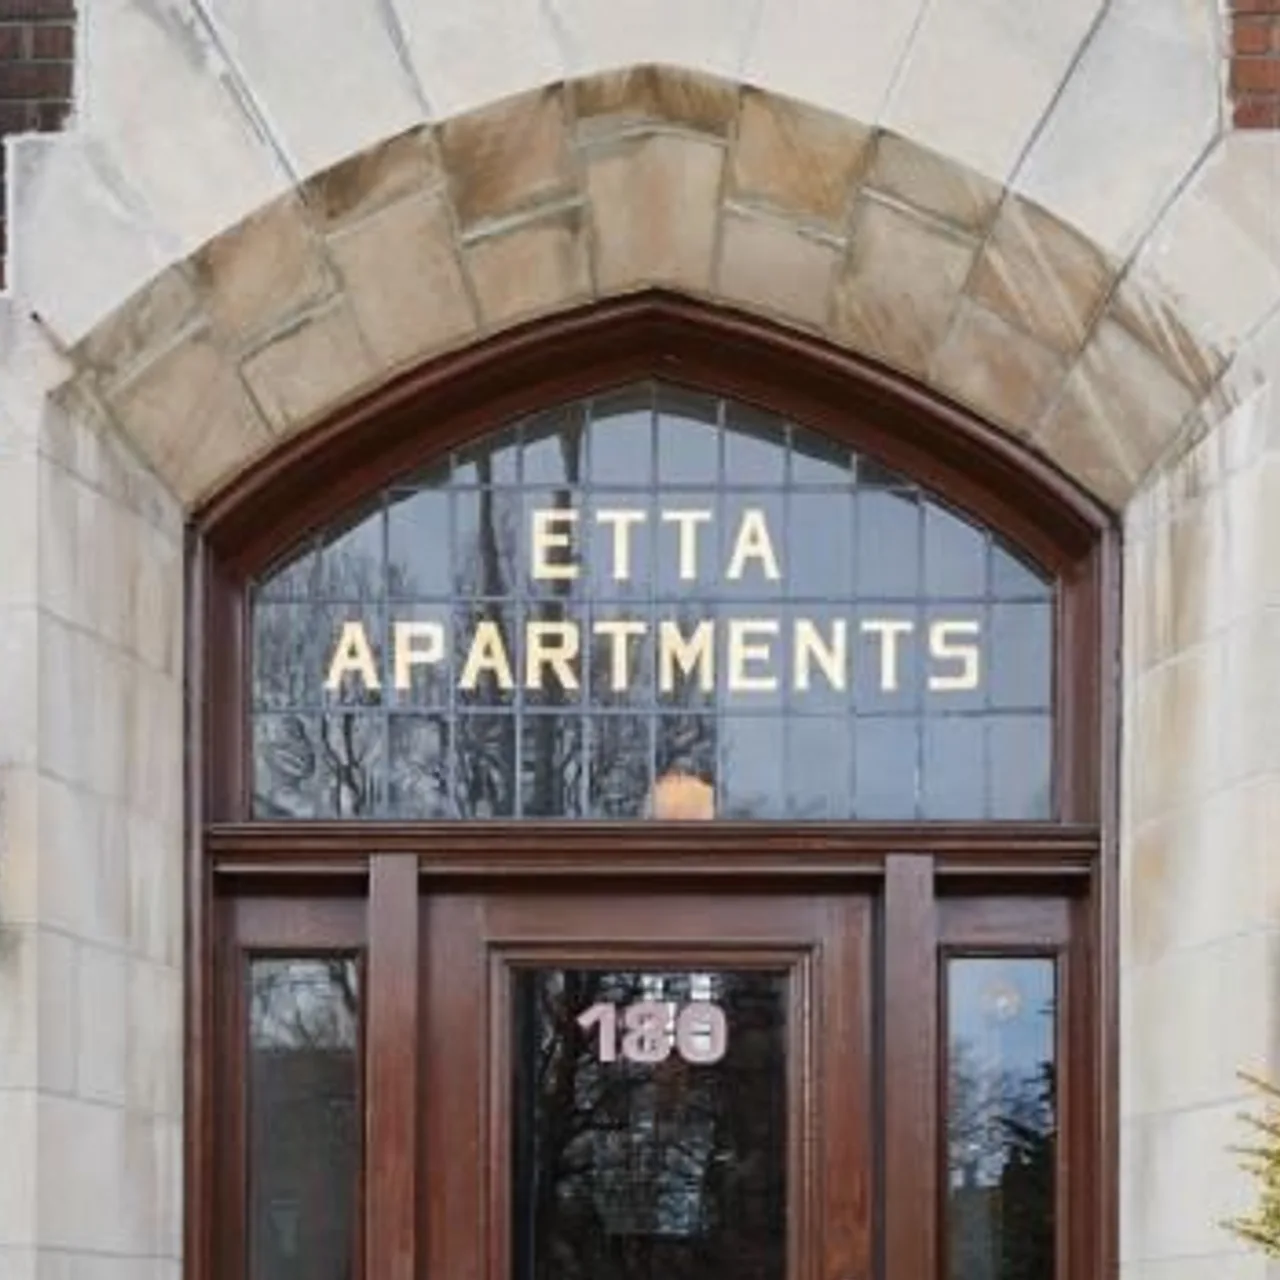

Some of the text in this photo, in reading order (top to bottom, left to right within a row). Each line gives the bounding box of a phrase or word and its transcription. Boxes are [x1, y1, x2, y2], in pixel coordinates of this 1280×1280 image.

[530, 509, 782, 582] ETTA
[324, 619, 981, 691] APARTMENTS
[576, 1001, 728, 1064] 180
